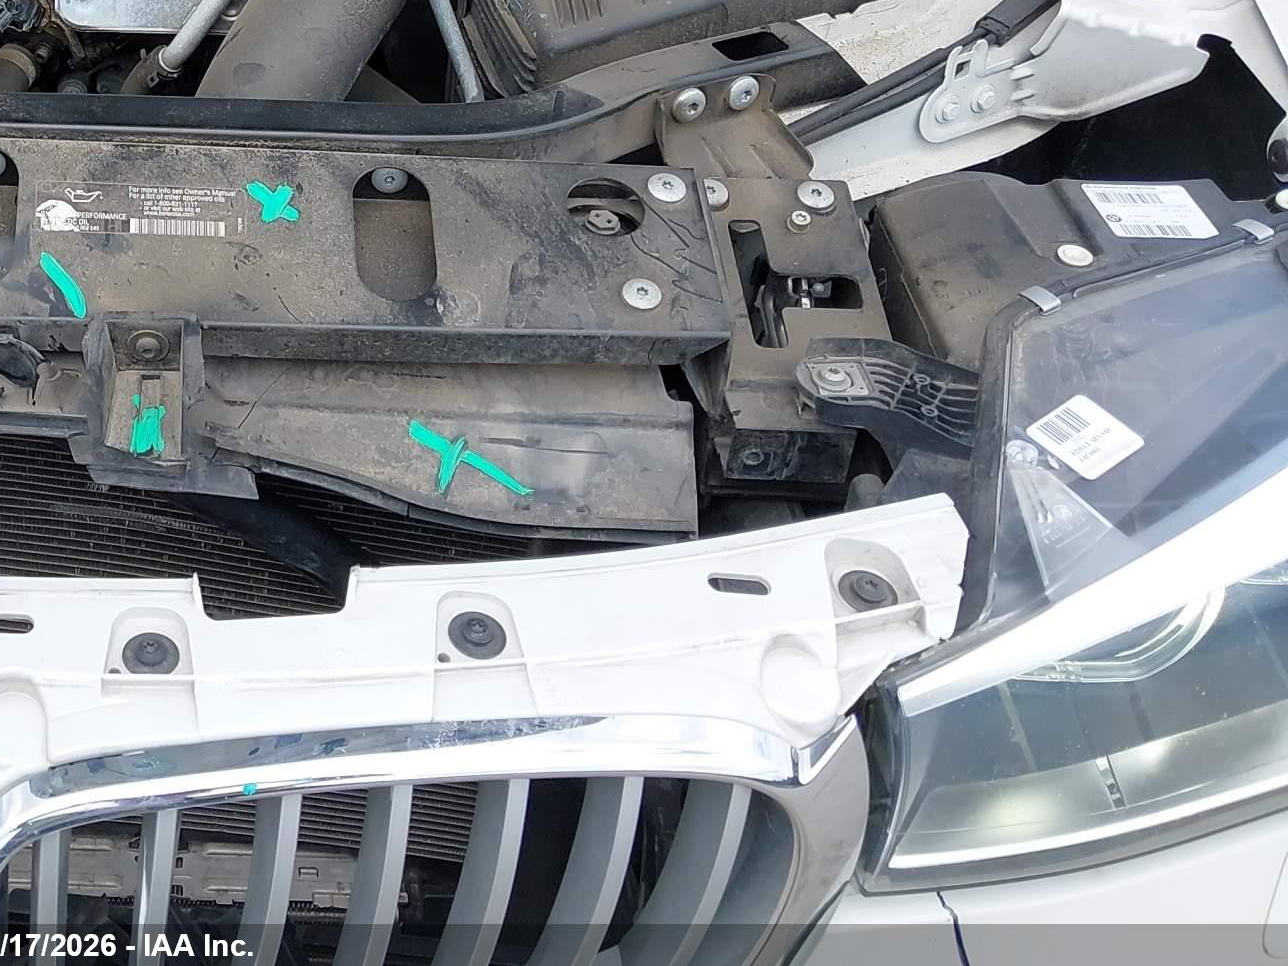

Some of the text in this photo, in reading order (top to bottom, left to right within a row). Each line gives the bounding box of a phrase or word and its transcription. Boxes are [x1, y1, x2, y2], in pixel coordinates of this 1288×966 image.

[128, 185, 140, 193] For
[184, 188, 211, 196] Owner's
[78, 218, 90, 226] OIL
